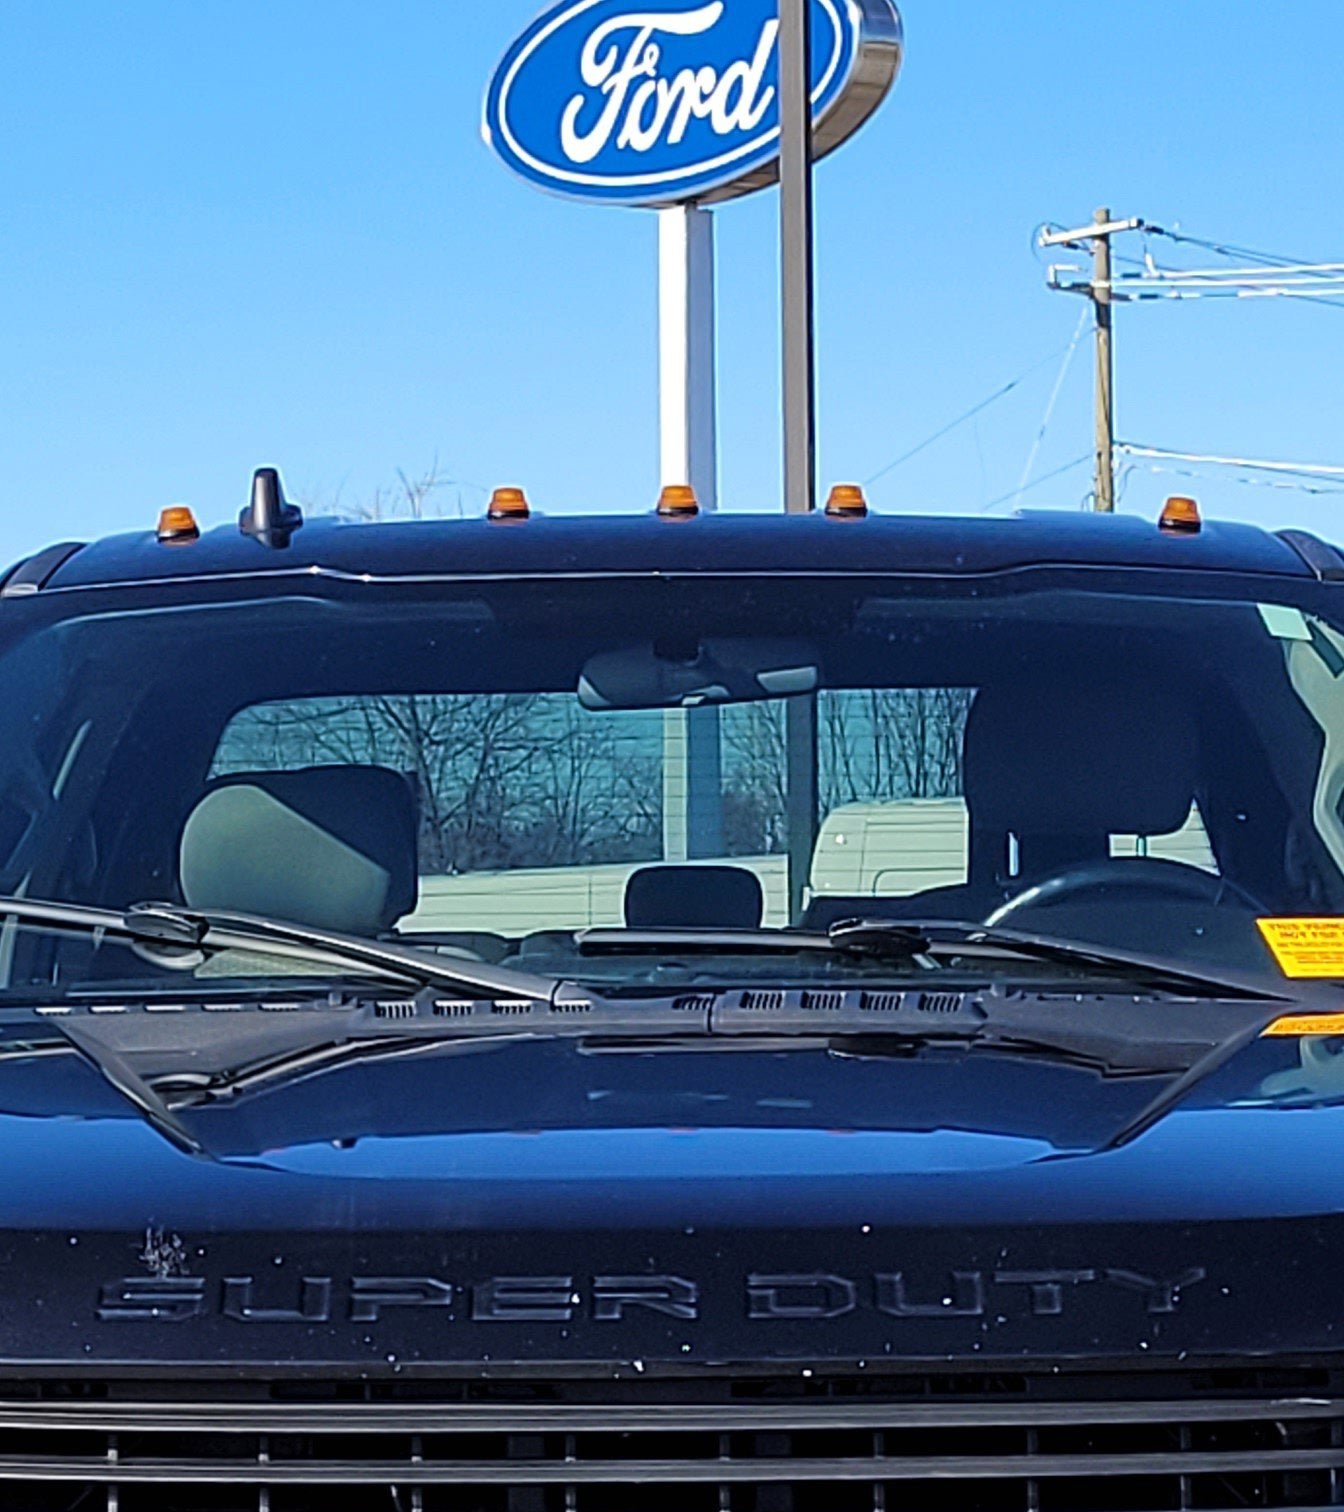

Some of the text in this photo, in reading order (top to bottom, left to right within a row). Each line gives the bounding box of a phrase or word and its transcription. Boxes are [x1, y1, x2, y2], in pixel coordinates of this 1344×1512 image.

[560, 0, 780, 163] Ford
[95, 1267, 1207, 1322] SUPER DUTY
